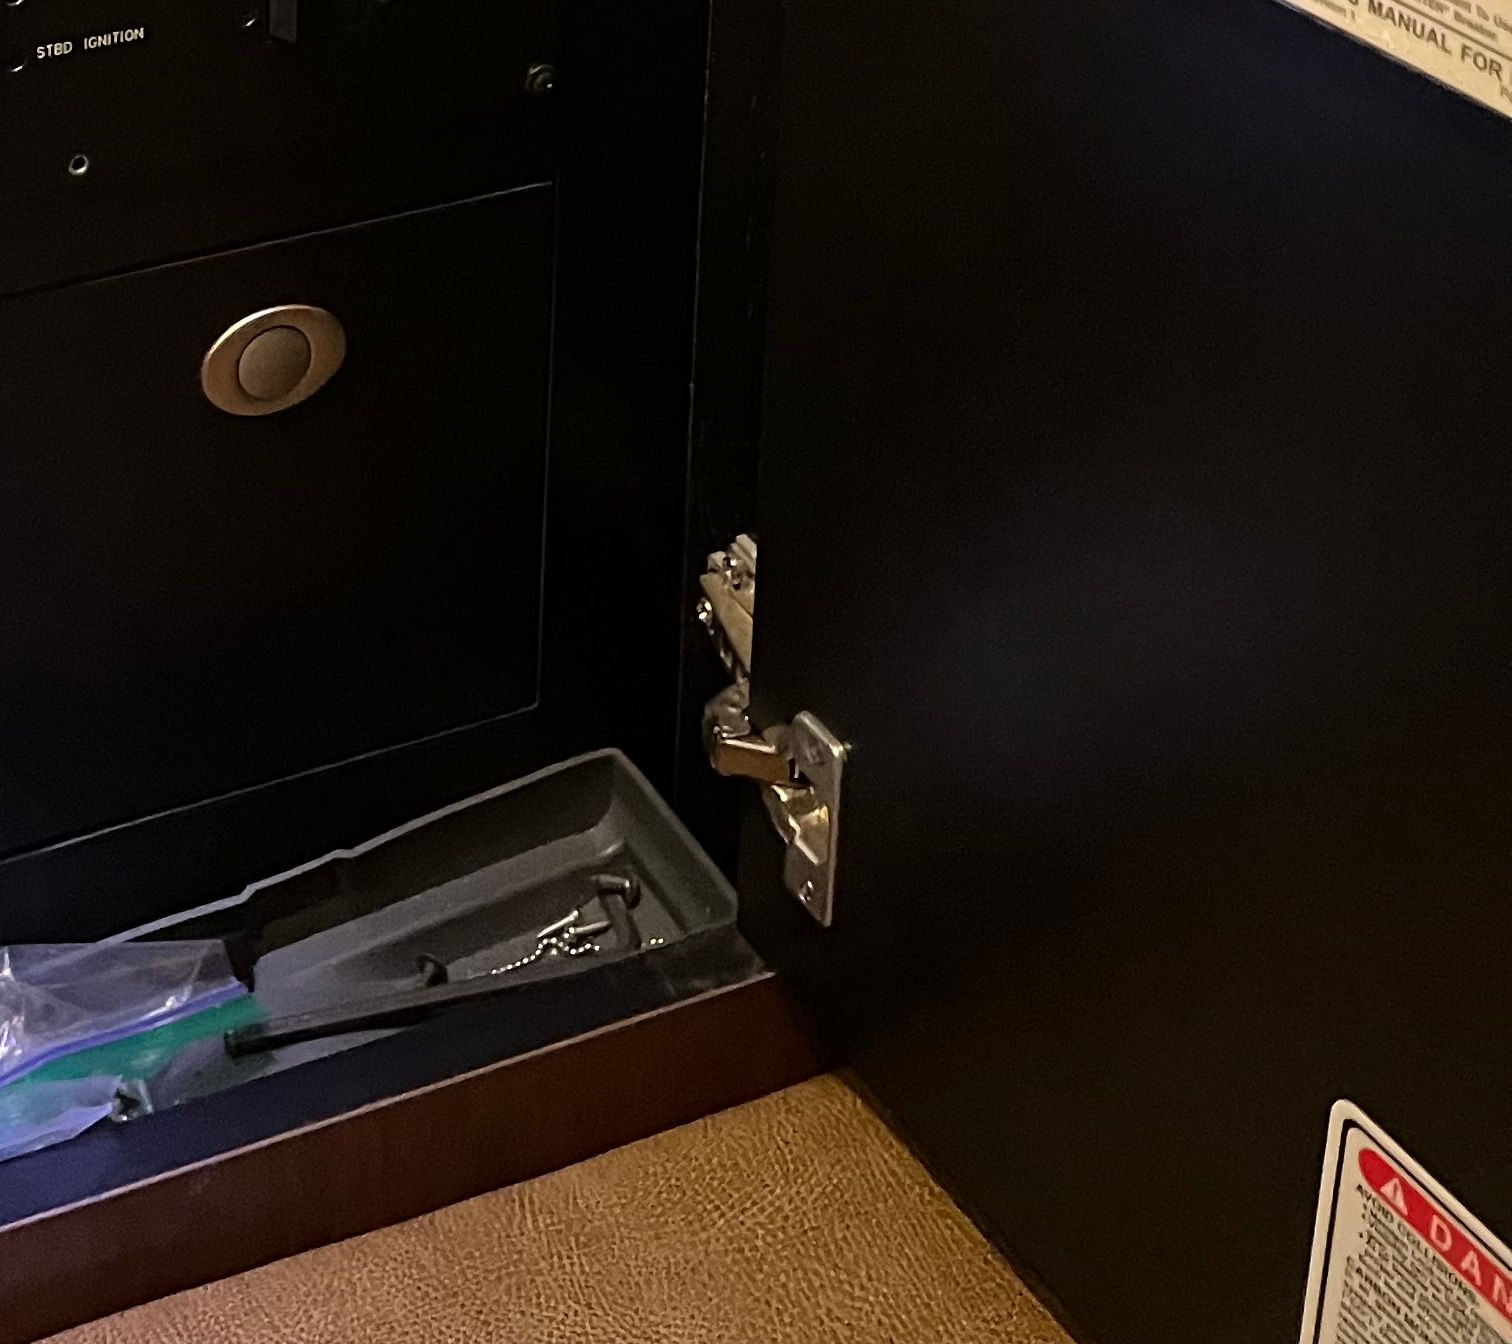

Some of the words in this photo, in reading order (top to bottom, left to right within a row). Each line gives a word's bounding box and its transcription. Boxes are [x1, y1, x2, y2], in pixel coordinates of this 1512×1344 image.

[37, 42, 72, 58] STBD
[84, 28, 144, 49] IGNITION
[1461, 45, 1503, 81] FOR
